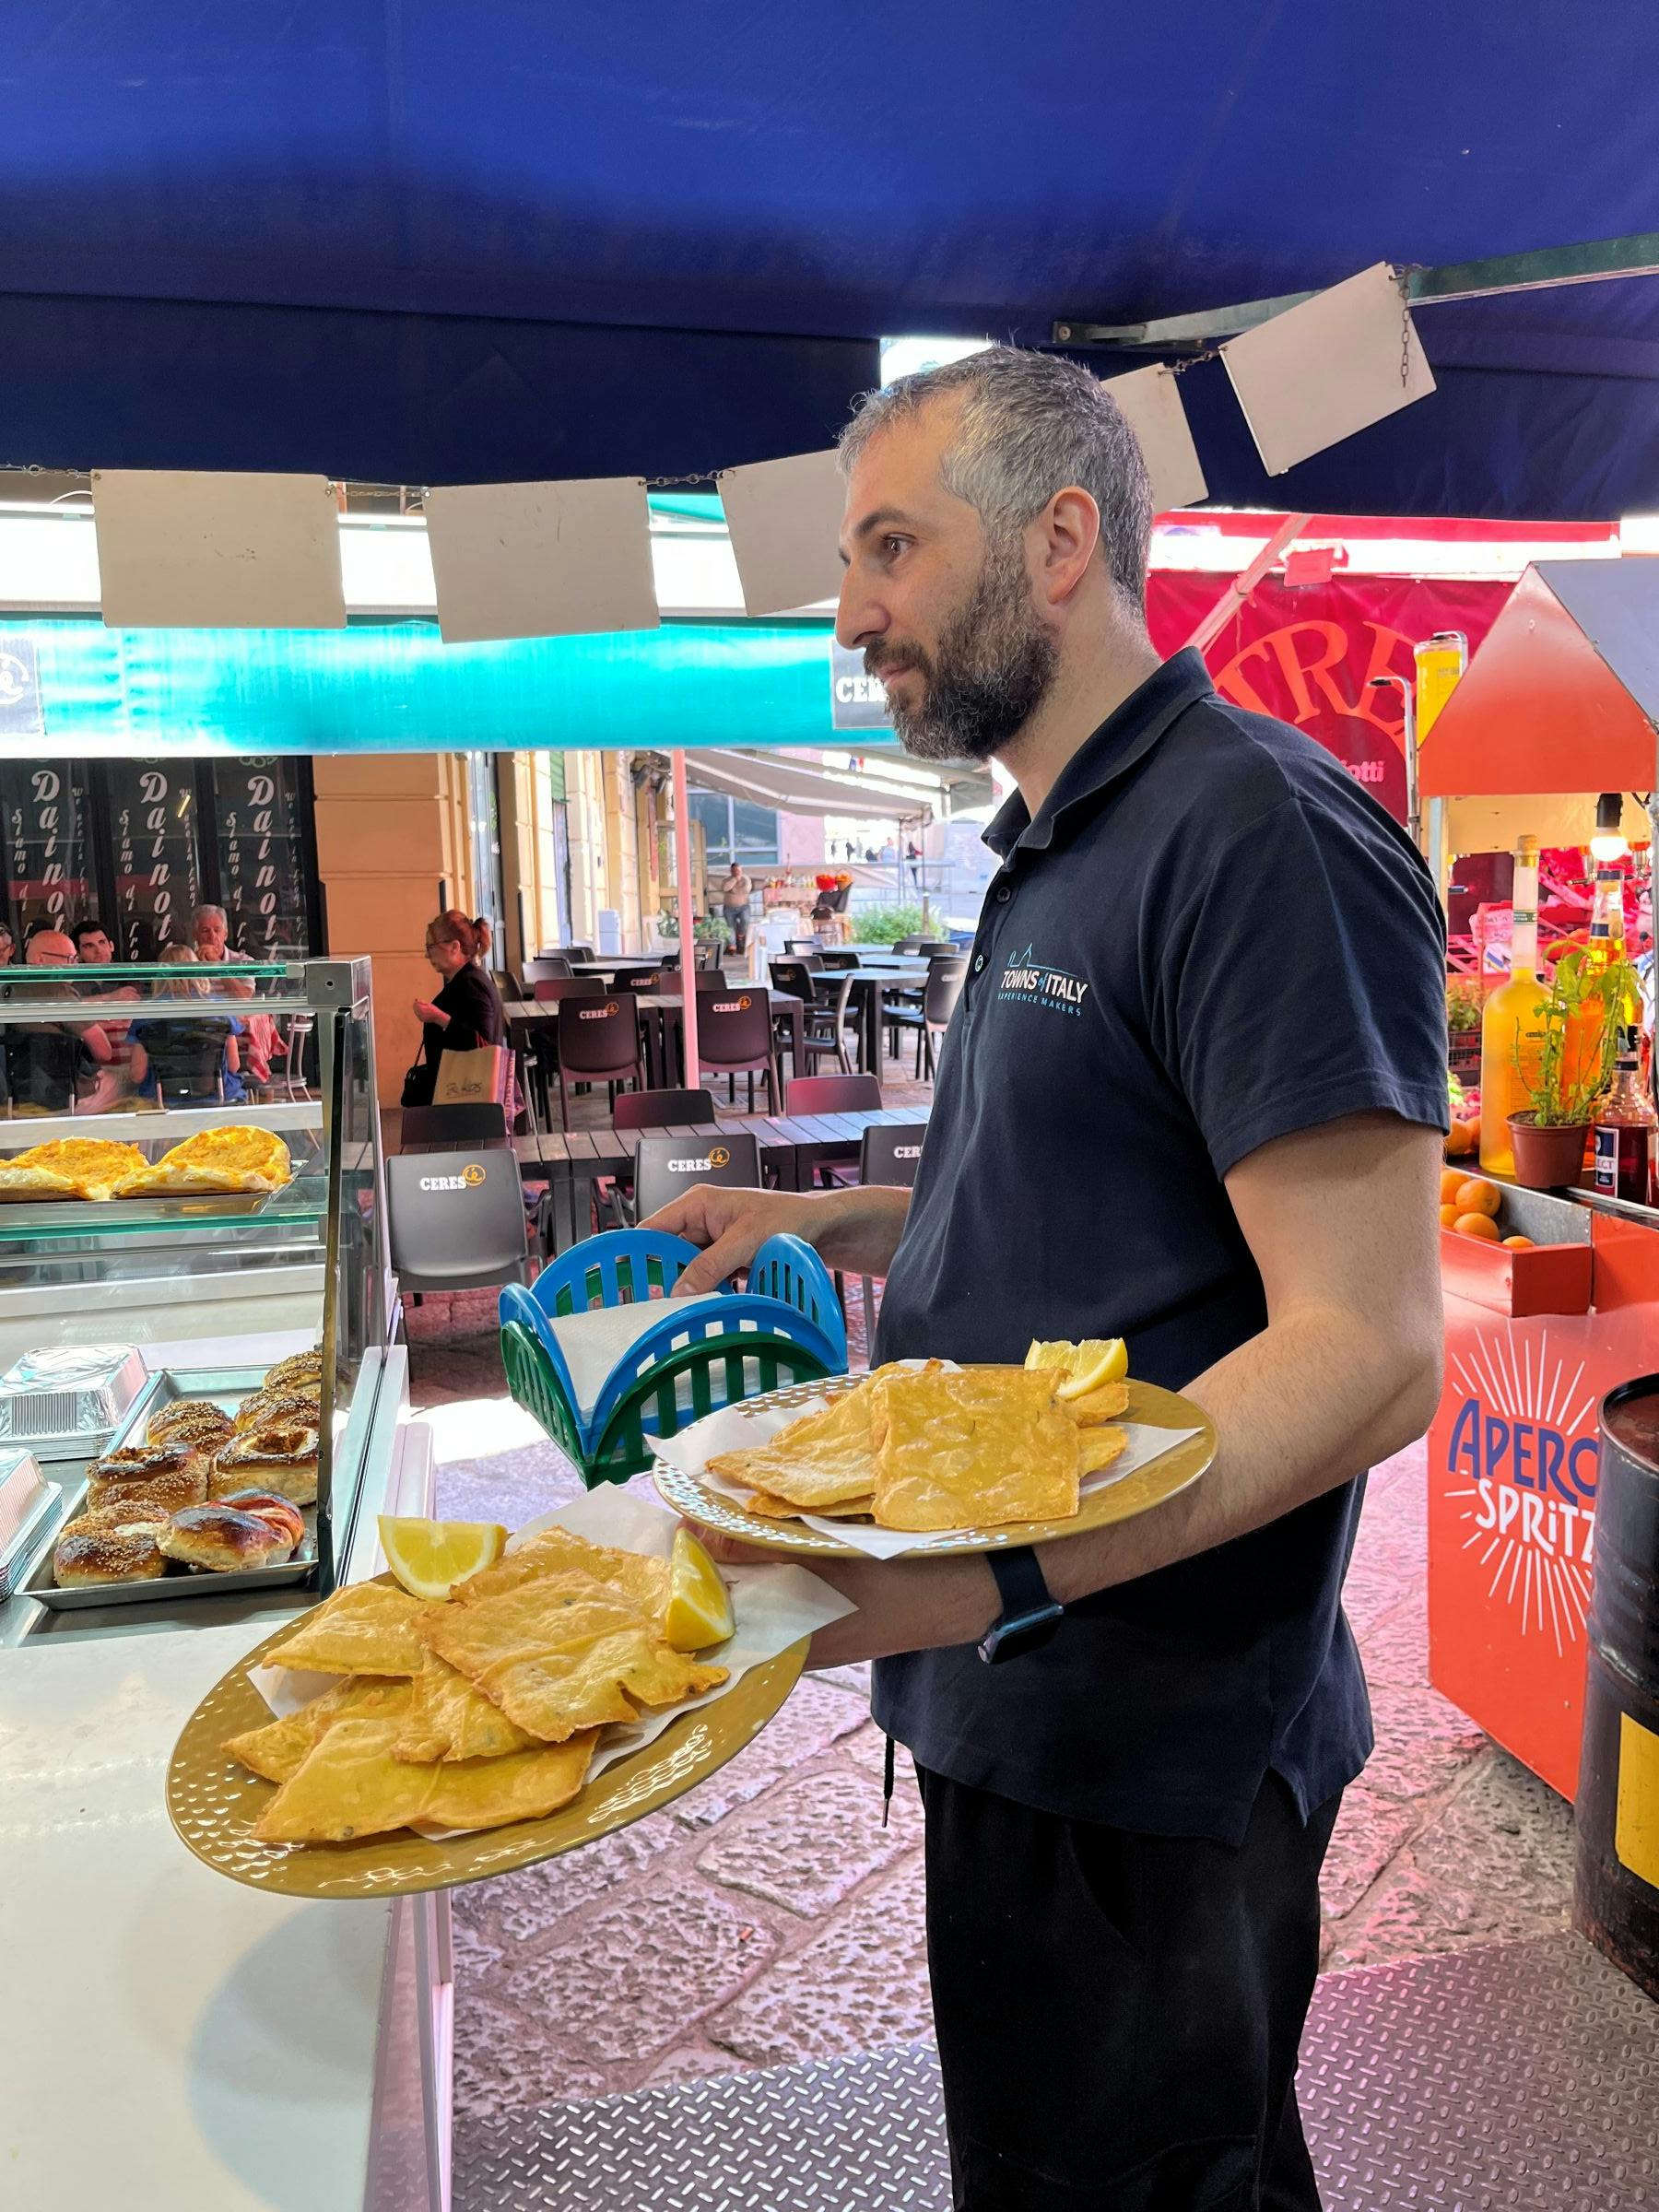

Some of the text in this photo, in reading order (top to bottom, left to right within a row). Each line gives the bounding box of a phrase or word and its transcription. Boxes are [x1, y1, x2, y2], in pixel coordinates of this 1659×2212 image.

[139, 771, 173, 947] Dainot
[1001, 970, 1040, 990] TOWNS
[1045, 973, 1088, 1004] ITALY
[579, 1009, 608, 1019] CERES
[712, 1003, 741, 1013] CERES
[1041, 997, 1082, 1017] MAKERS
[667, 1158, 712, 1172] CERES
[419, 1176, 467, 1191] CERES
